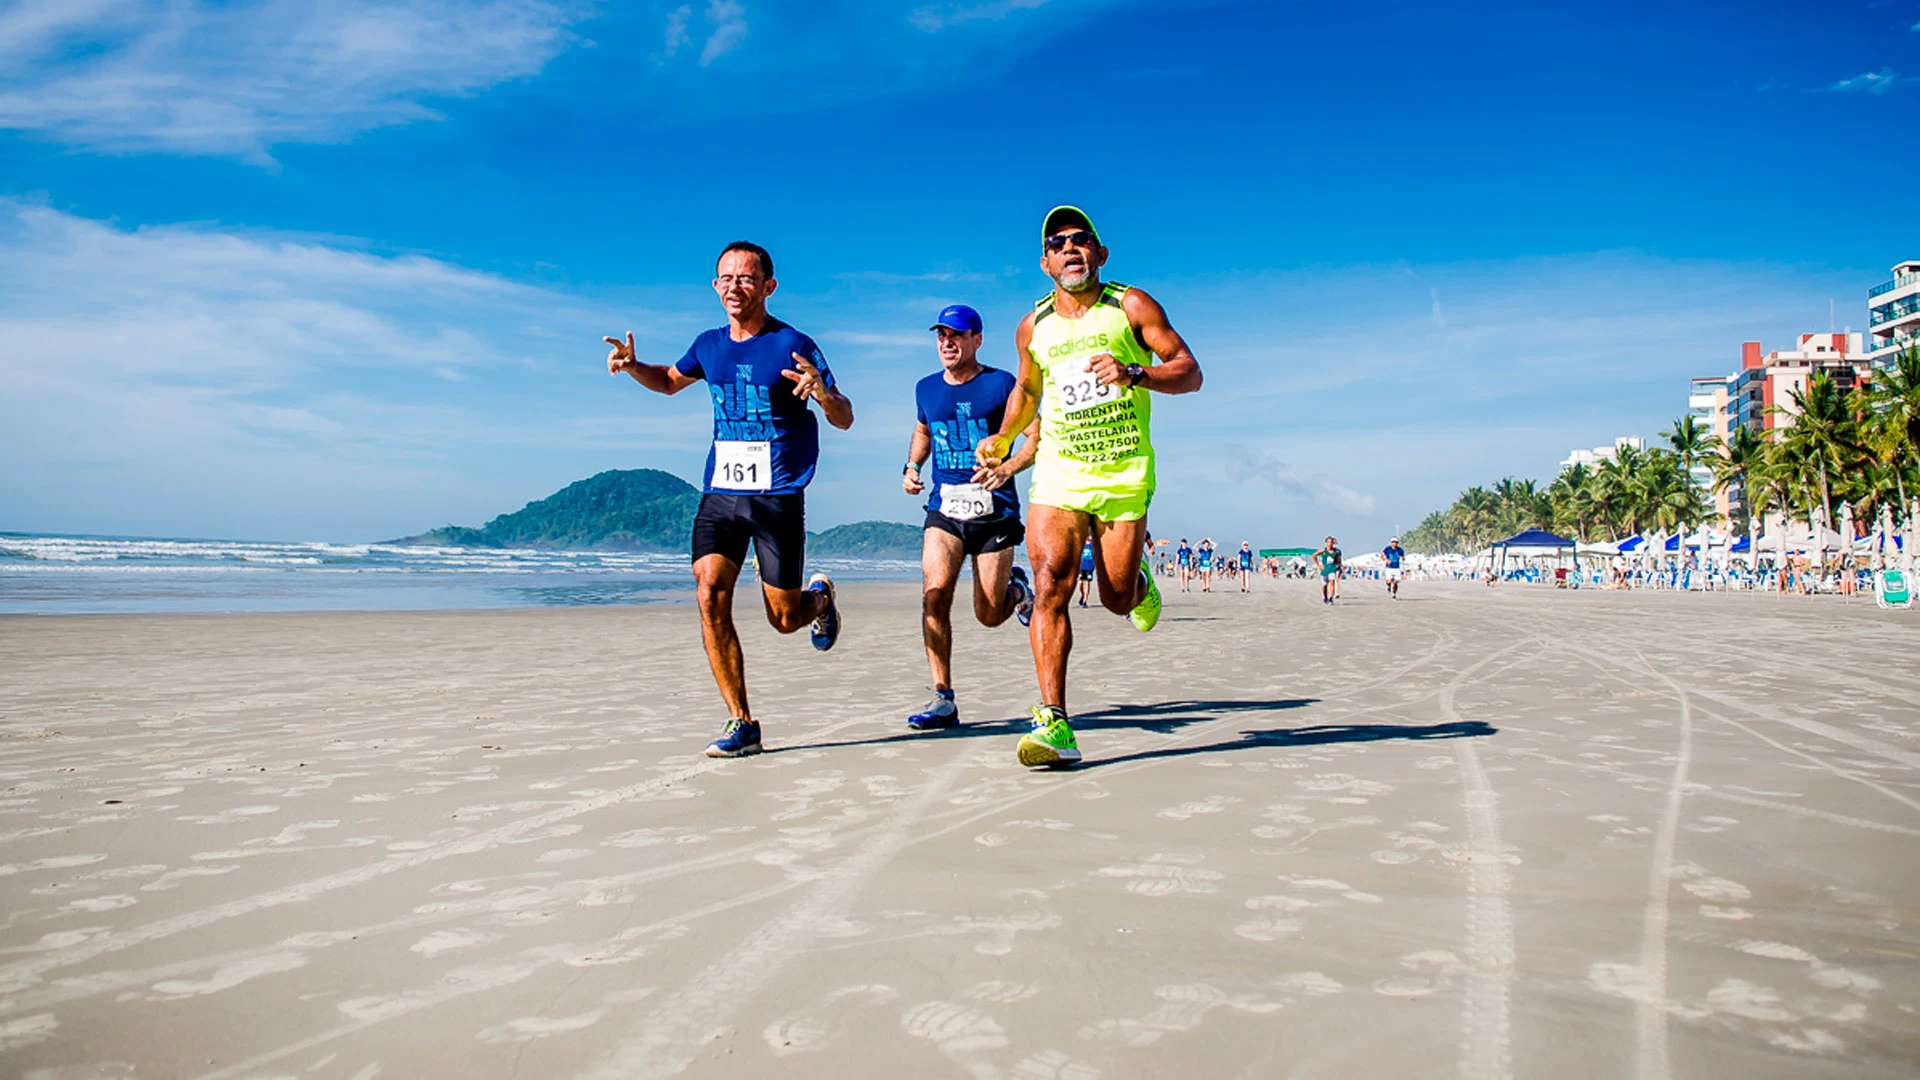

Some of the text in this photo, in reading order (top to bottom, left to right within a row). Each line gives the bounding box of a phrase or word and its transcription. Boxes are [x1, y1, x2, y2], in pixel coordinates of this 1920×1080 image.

[1048, 333, 1109, 358] adidas
[709, 379, 772, 421] RUN
[1063, 378, 1109, 406] 325
[1065, 400, 1134, 421] FIORENTINA
[1080, 411, 1137, 428] PIZZARIA
[930, 417, 989, 451] RUN
[1070, 424, 1138, 442] PASTELARIA
[1073, 436, 1140, 453] 3312-7500
[935, 451, 977, 470] RIVIE
[723, 462, 757, 482] 161
